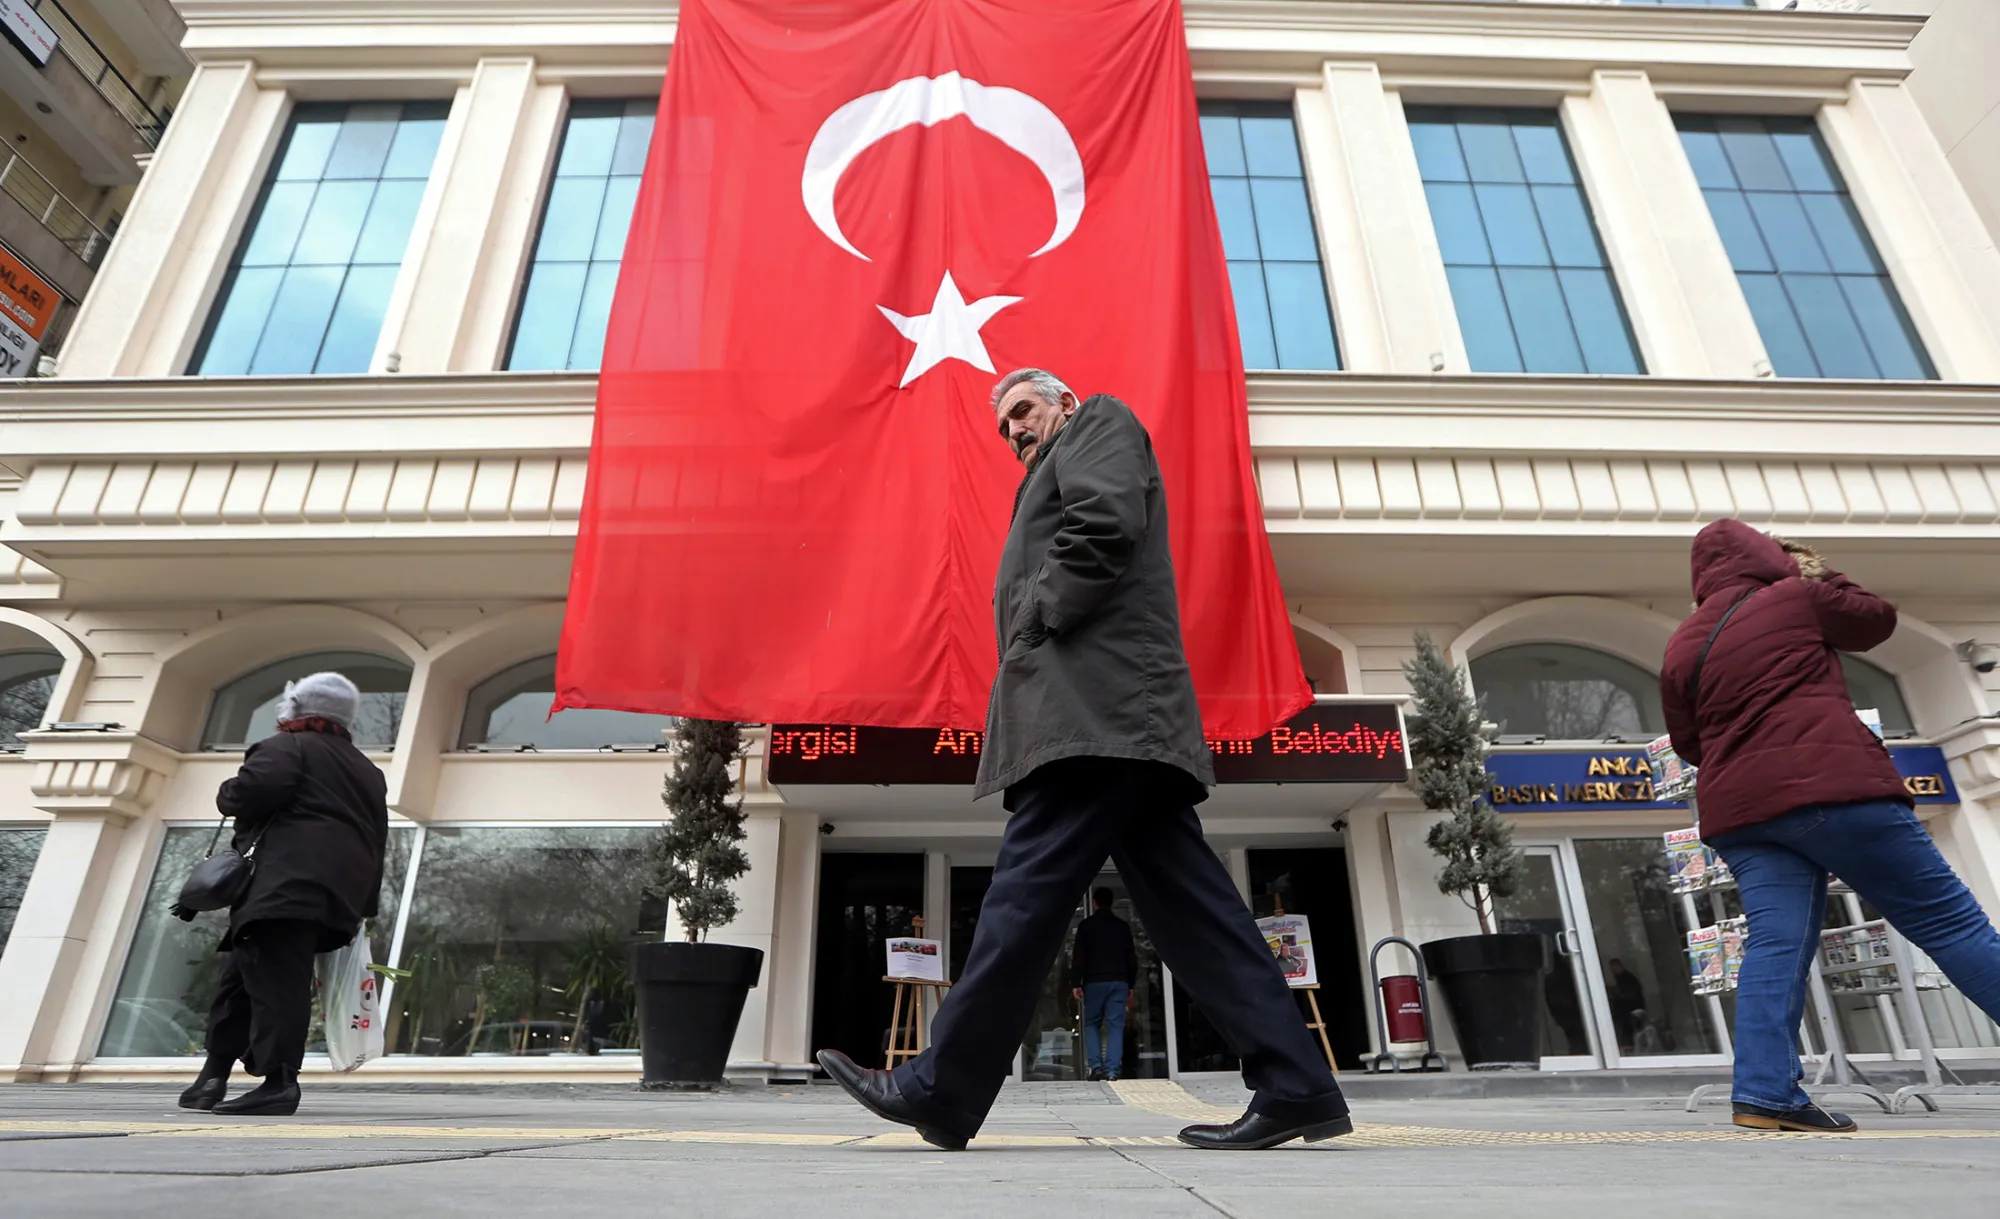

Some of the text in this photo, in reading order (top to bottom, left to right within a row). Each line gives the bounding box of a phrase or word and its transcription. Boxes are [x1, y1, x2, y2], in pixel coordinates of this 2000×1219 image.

[933, 727, 985, 754] An
[1491, 783, 1558, 803] BASIN
[1565, 777, 1656, 801] MERKEZİ
